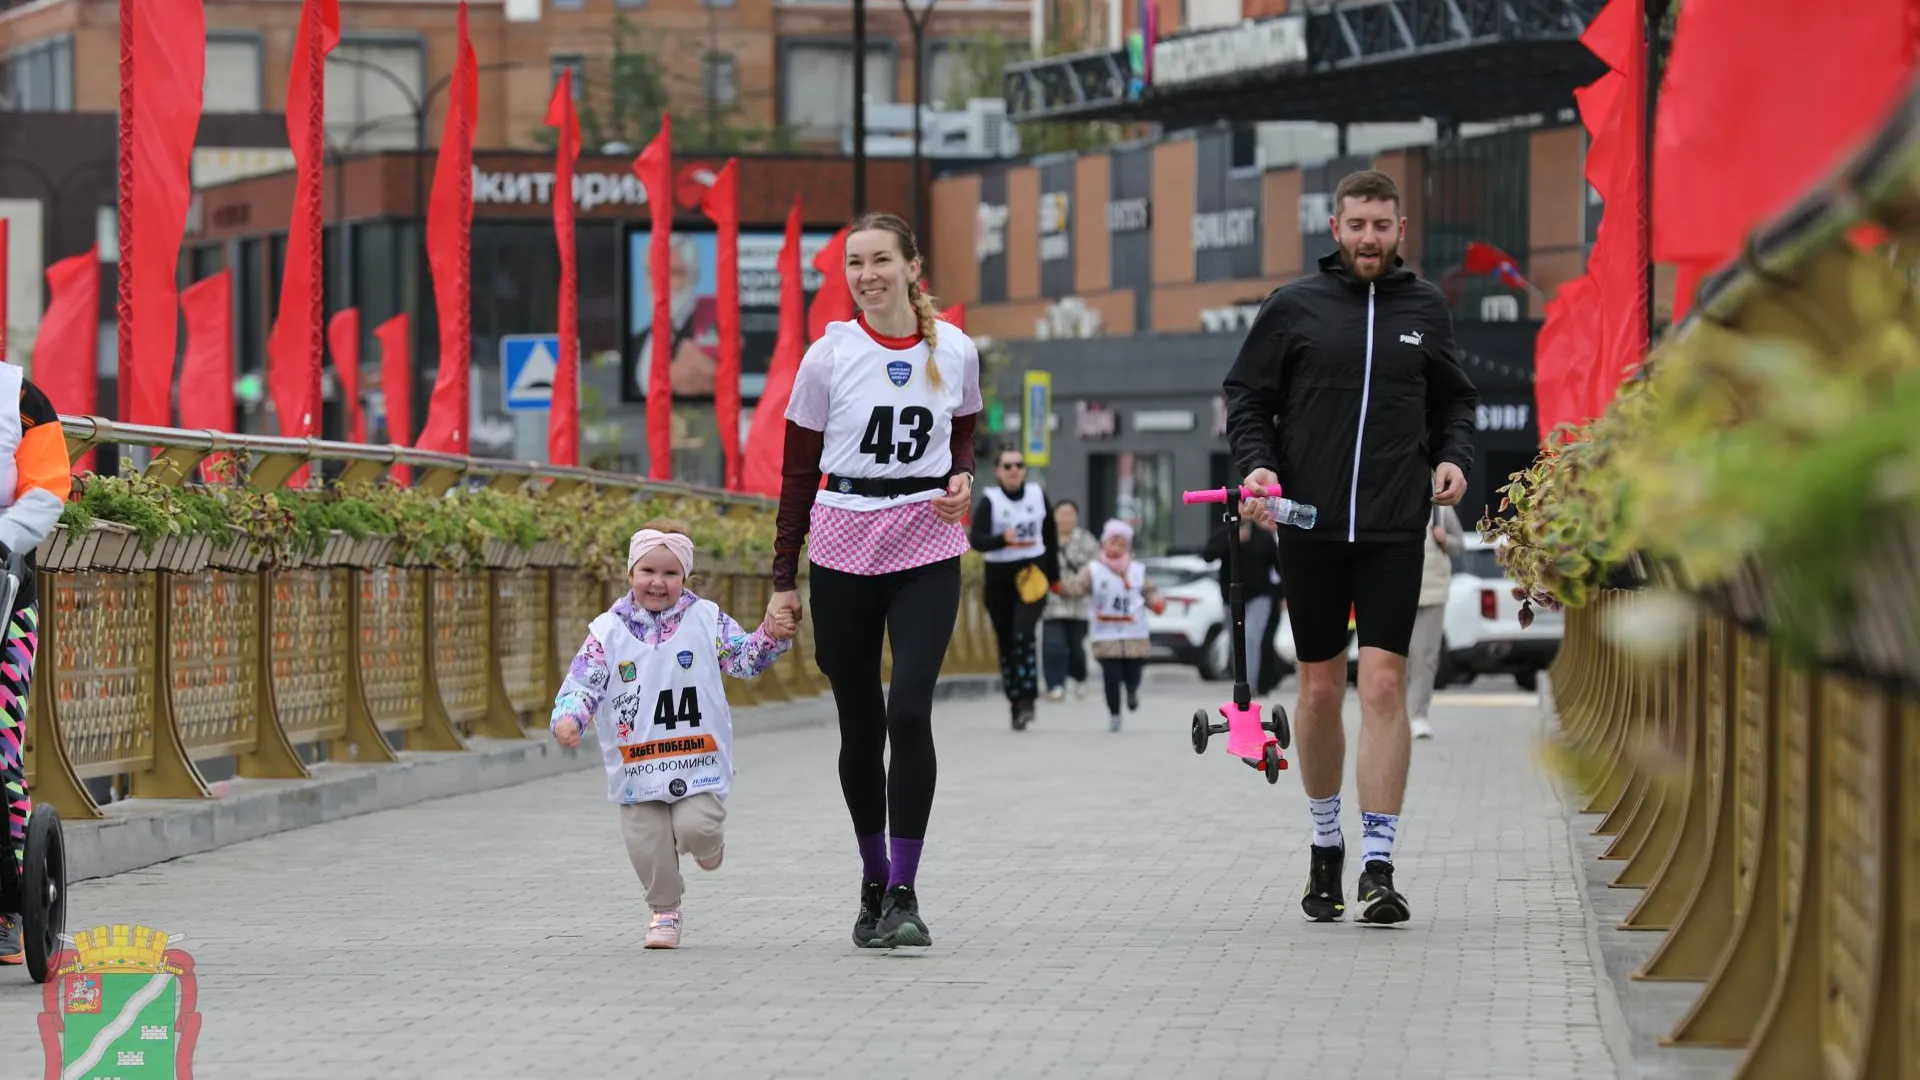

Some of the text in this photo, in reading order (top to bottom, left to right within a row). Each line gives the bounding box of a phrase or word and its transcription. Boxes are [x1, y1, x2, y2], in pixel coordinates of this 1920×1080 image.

[1475, 404, 1529, 431] SURF
[860, 405, 934, 465] 43
[653, 686, 702, 730] 44
[629, 743, 656, 758] ЗАБЕГ
[624, 755, 719, 778] НАРО-ФОМИНСК
